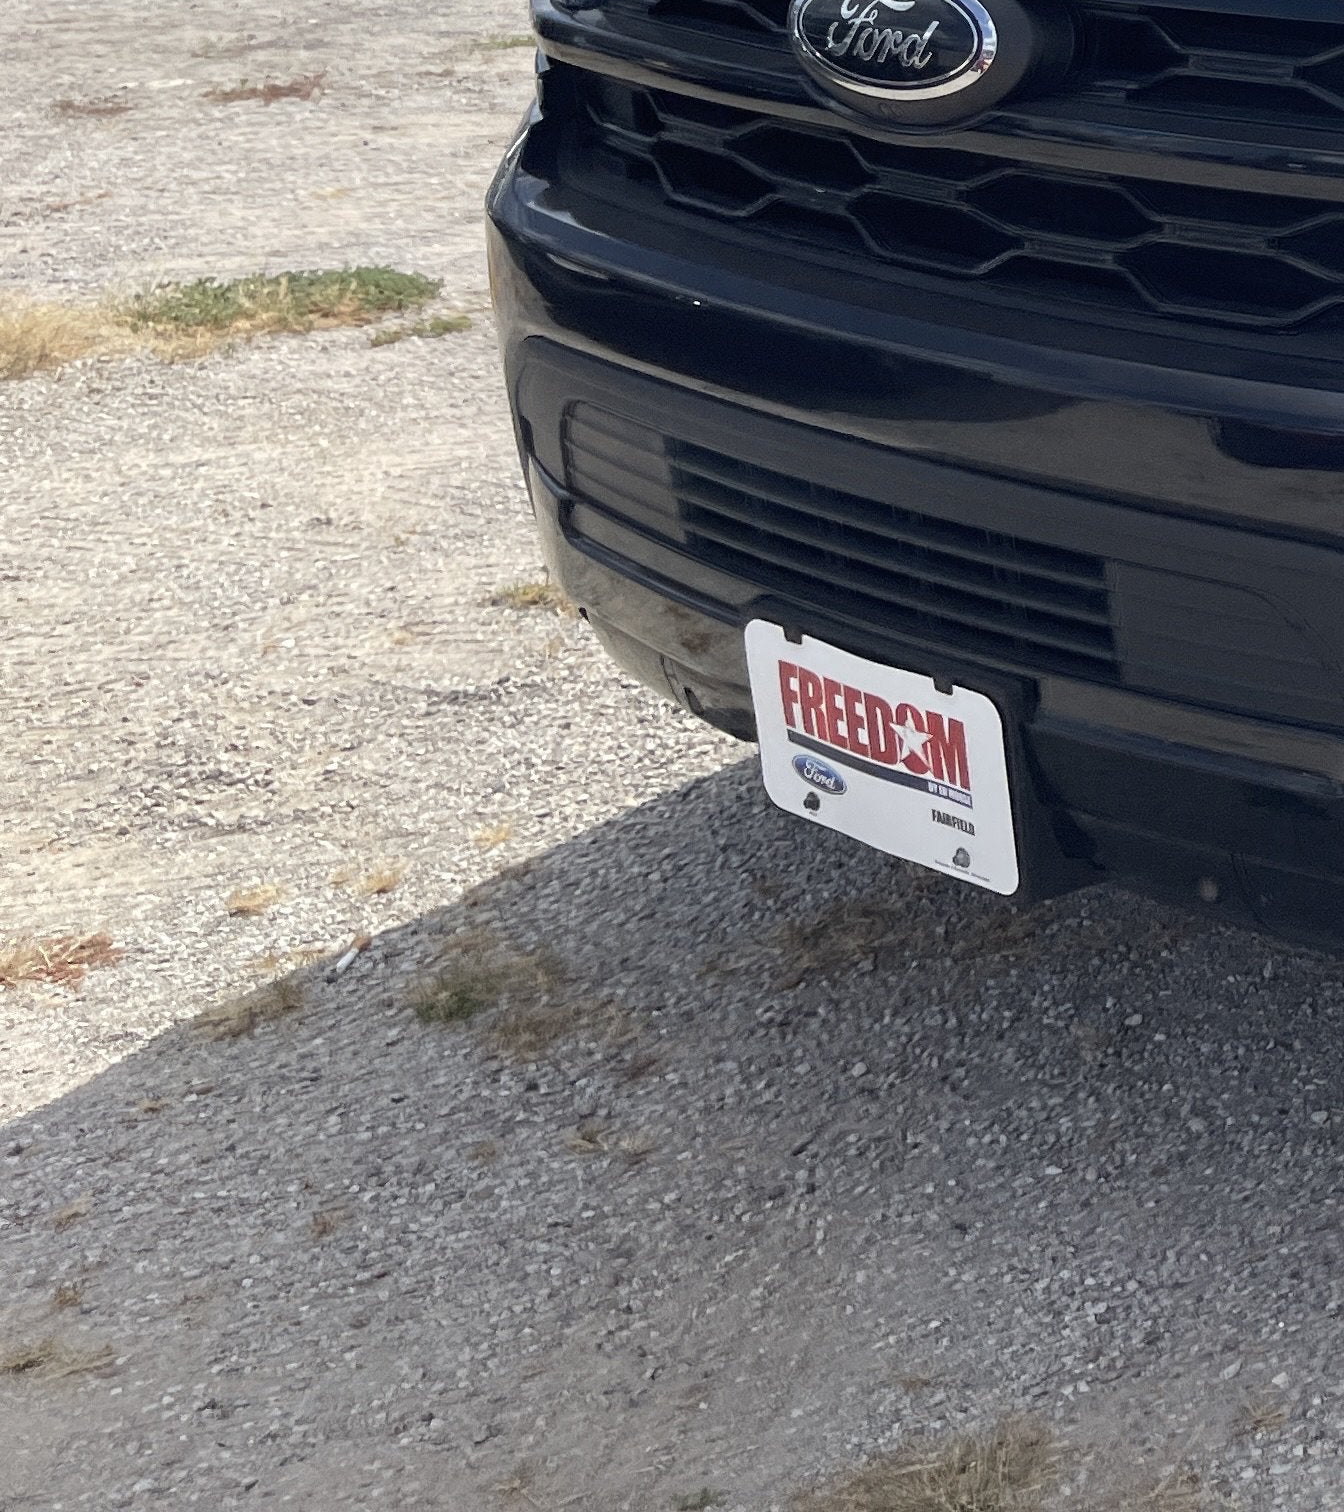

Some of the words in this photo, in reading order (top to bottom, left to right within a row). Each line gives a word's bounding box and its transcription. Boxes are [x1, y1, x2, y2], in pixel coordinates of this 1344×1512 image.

[777, 659, 971, 792] FREEDOM
[804, 759, 836, 790] Ford
[931, 809, 976, 836] FAIRFIELD
